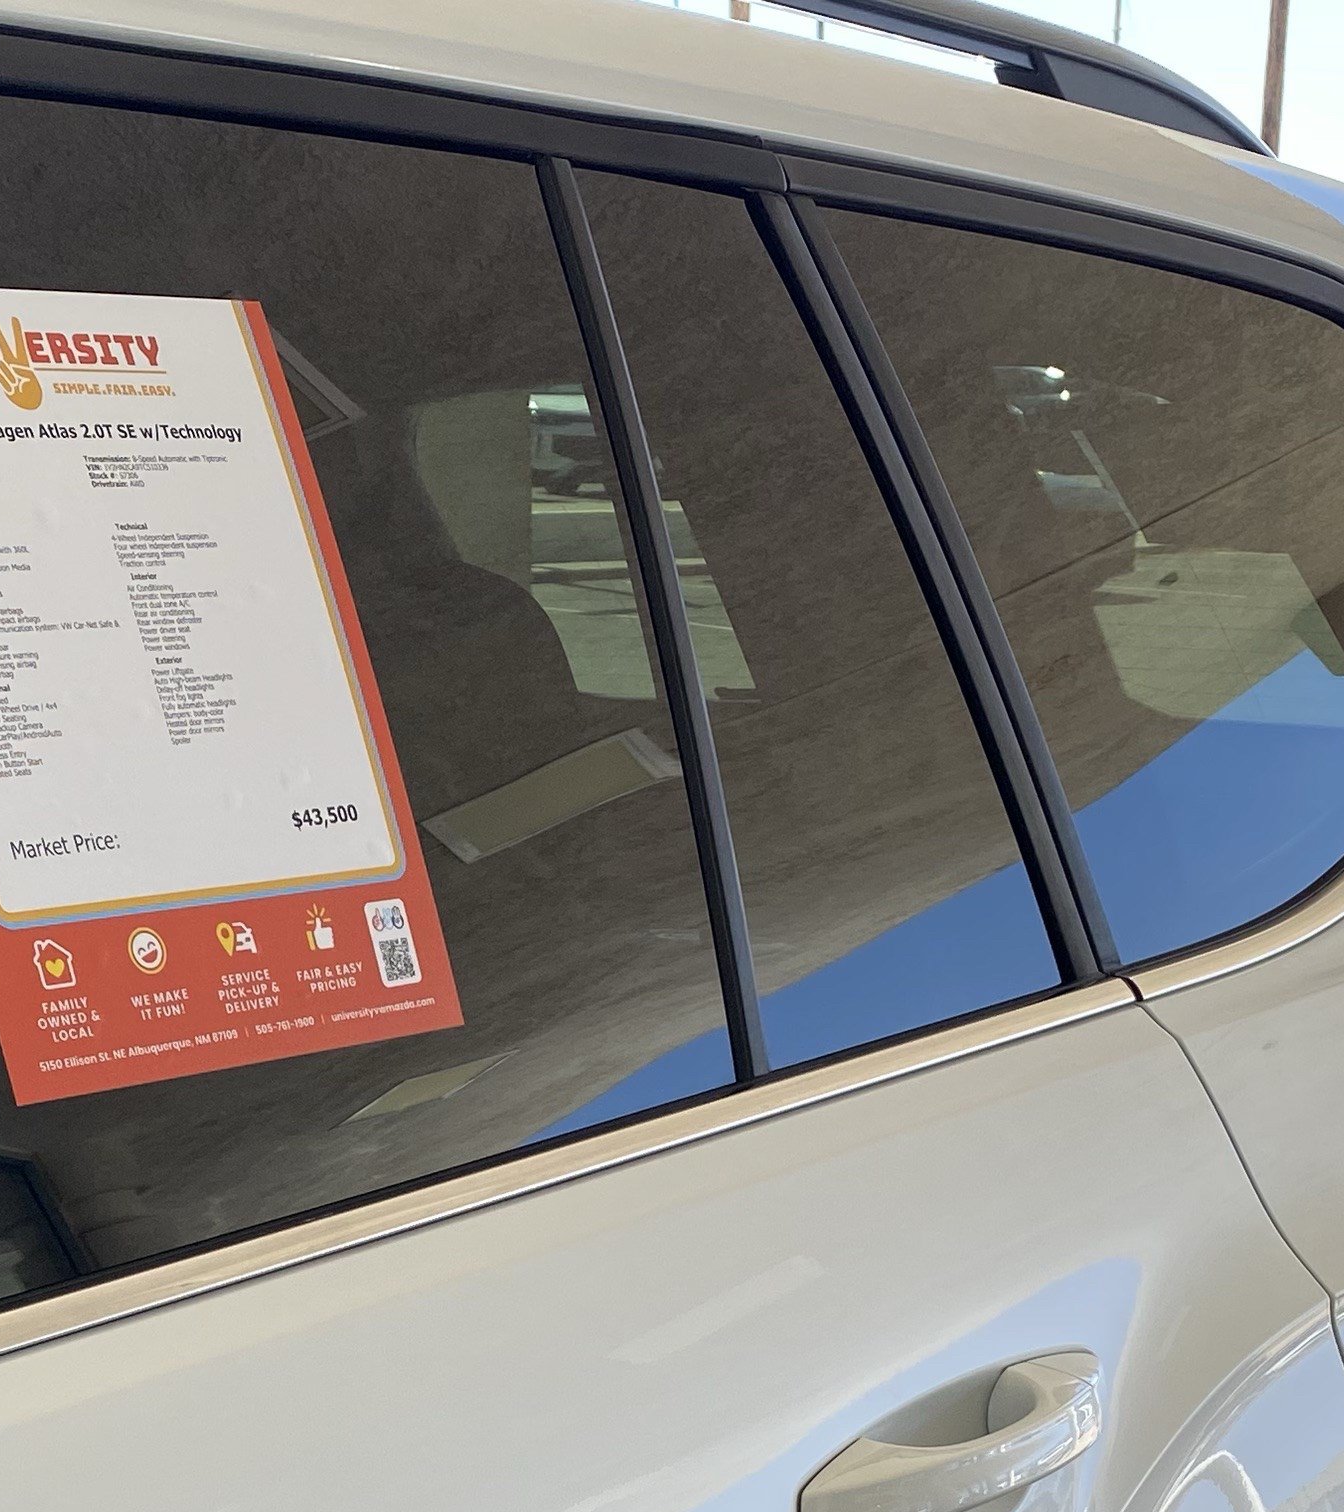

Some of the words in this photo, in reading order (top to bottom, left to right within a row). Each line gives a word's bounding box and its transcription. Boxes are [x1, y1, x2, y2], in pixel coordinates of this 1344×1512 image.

[38, 422, 77, 440] Atlas
[79, 422, 113, 441] 2.0T
[117, 423, 137, 441] SE
[140, 422, 242, 444] w/Technology
[10, 835, 70, 861] Market
[73, 832, 121, 855] Price:
[291, 803, 358, 831] $43,500
[220, 969, 270, 986] SERVICE
[296, 968, 321, 981] FAIR
[324, 966, 333, 977] &
[335, 961, 363, 975] EASY
[218, 983, 269, 1001] PICK-UP
[271, 981, 280, 992] &
[309, 976, 356, 993] PRICING
[41, 996, 89, 1014] FAMILY
[130, 994, 151, 1007] WE
[153, 988, 188, 1004] MAKE
[225, 995, 280, 1014] DELIVERY
[36, 1011, 87, 1029] OWNED
[90, 1009, 100, 1021] &
[140, 1009, 152, 1020] IT
[155, 1003, 186, 1018] FUN!
[51, 1025, 94, 1042] LOCAL
[255, 1016, 315, 1035] 505-761-1900
[39, 1058, 62, 1072] 5150
[63, 1053, 97, 1068] Ellison
[112, 1048, 126, 1059] NE
[194, 1033, 211, 1045] NM
[211, 1029, 238, 1042] 87109
